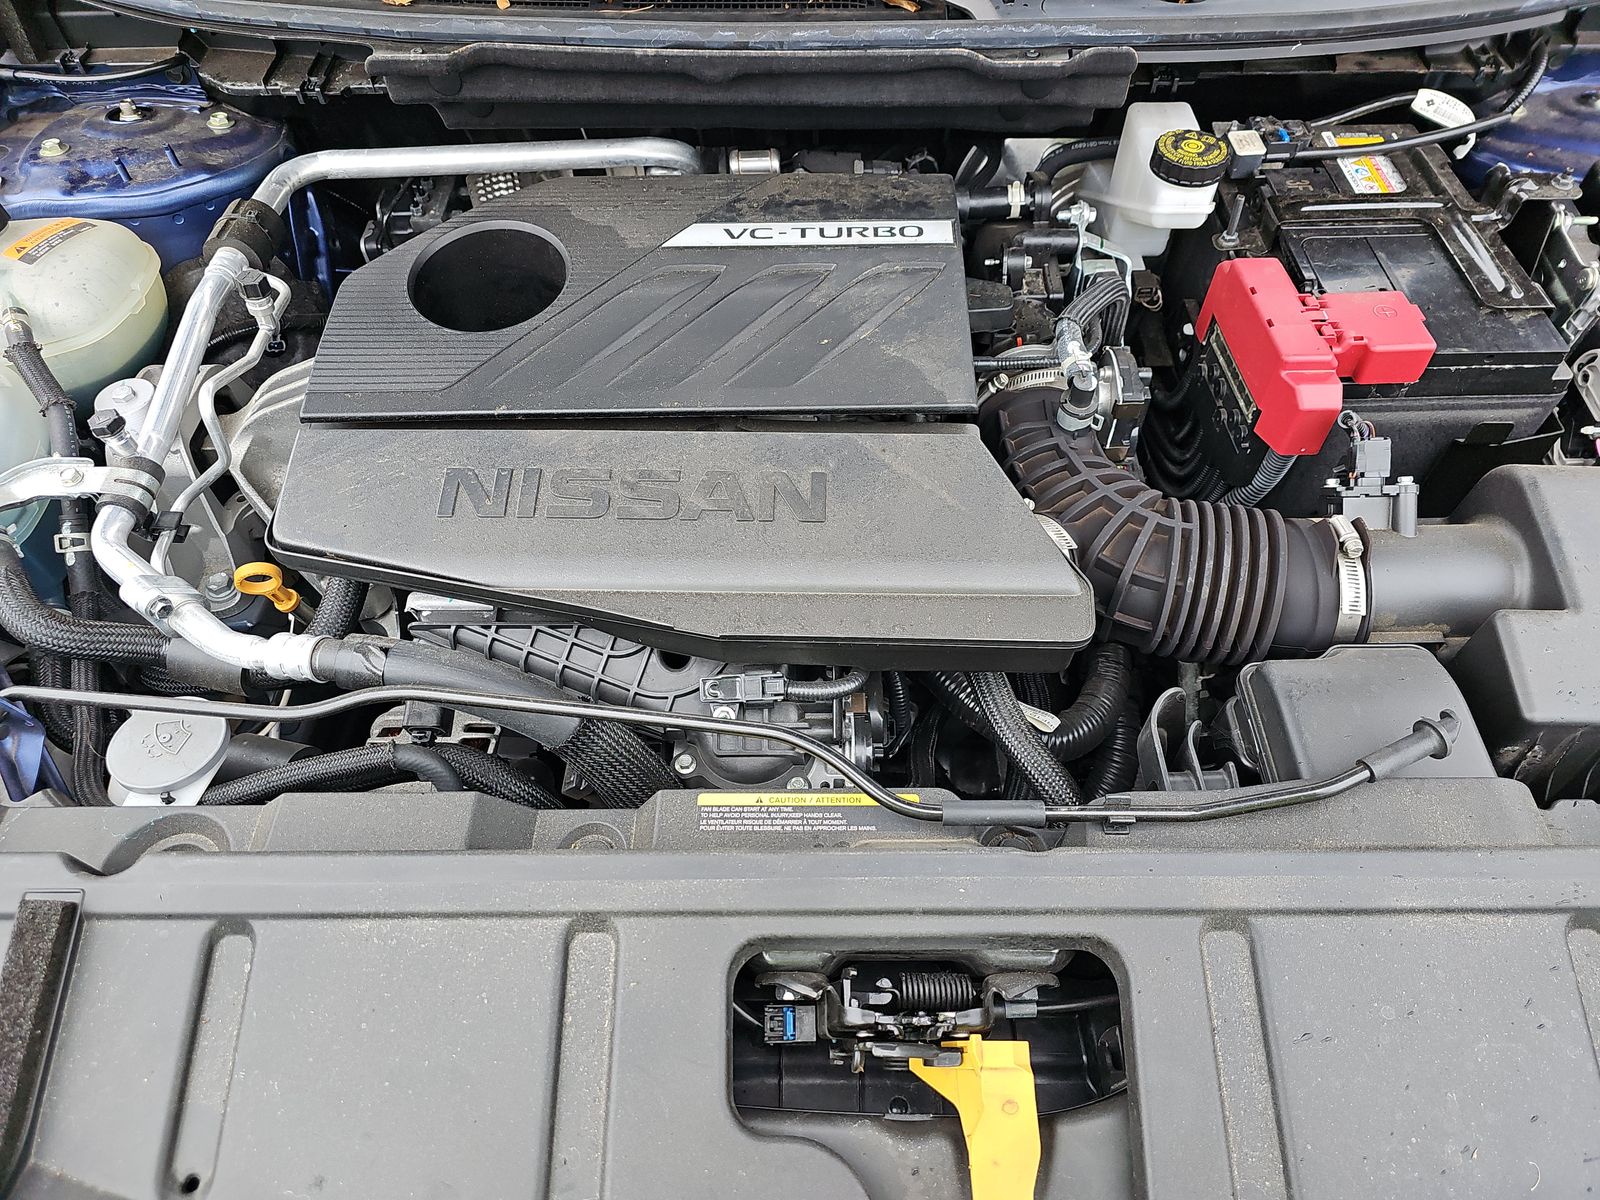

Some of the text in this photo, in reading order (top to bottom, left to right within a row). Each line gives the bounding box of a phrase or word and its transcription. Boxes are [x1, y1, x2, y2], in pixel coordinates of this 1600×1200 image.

[723, 225, 924, 240] VC-TURBO
[436, 467, 828, 522] NISSAN
[768, 796, 807, 804] CAUTION
[815, 796, 862, 804] ATTENTION
